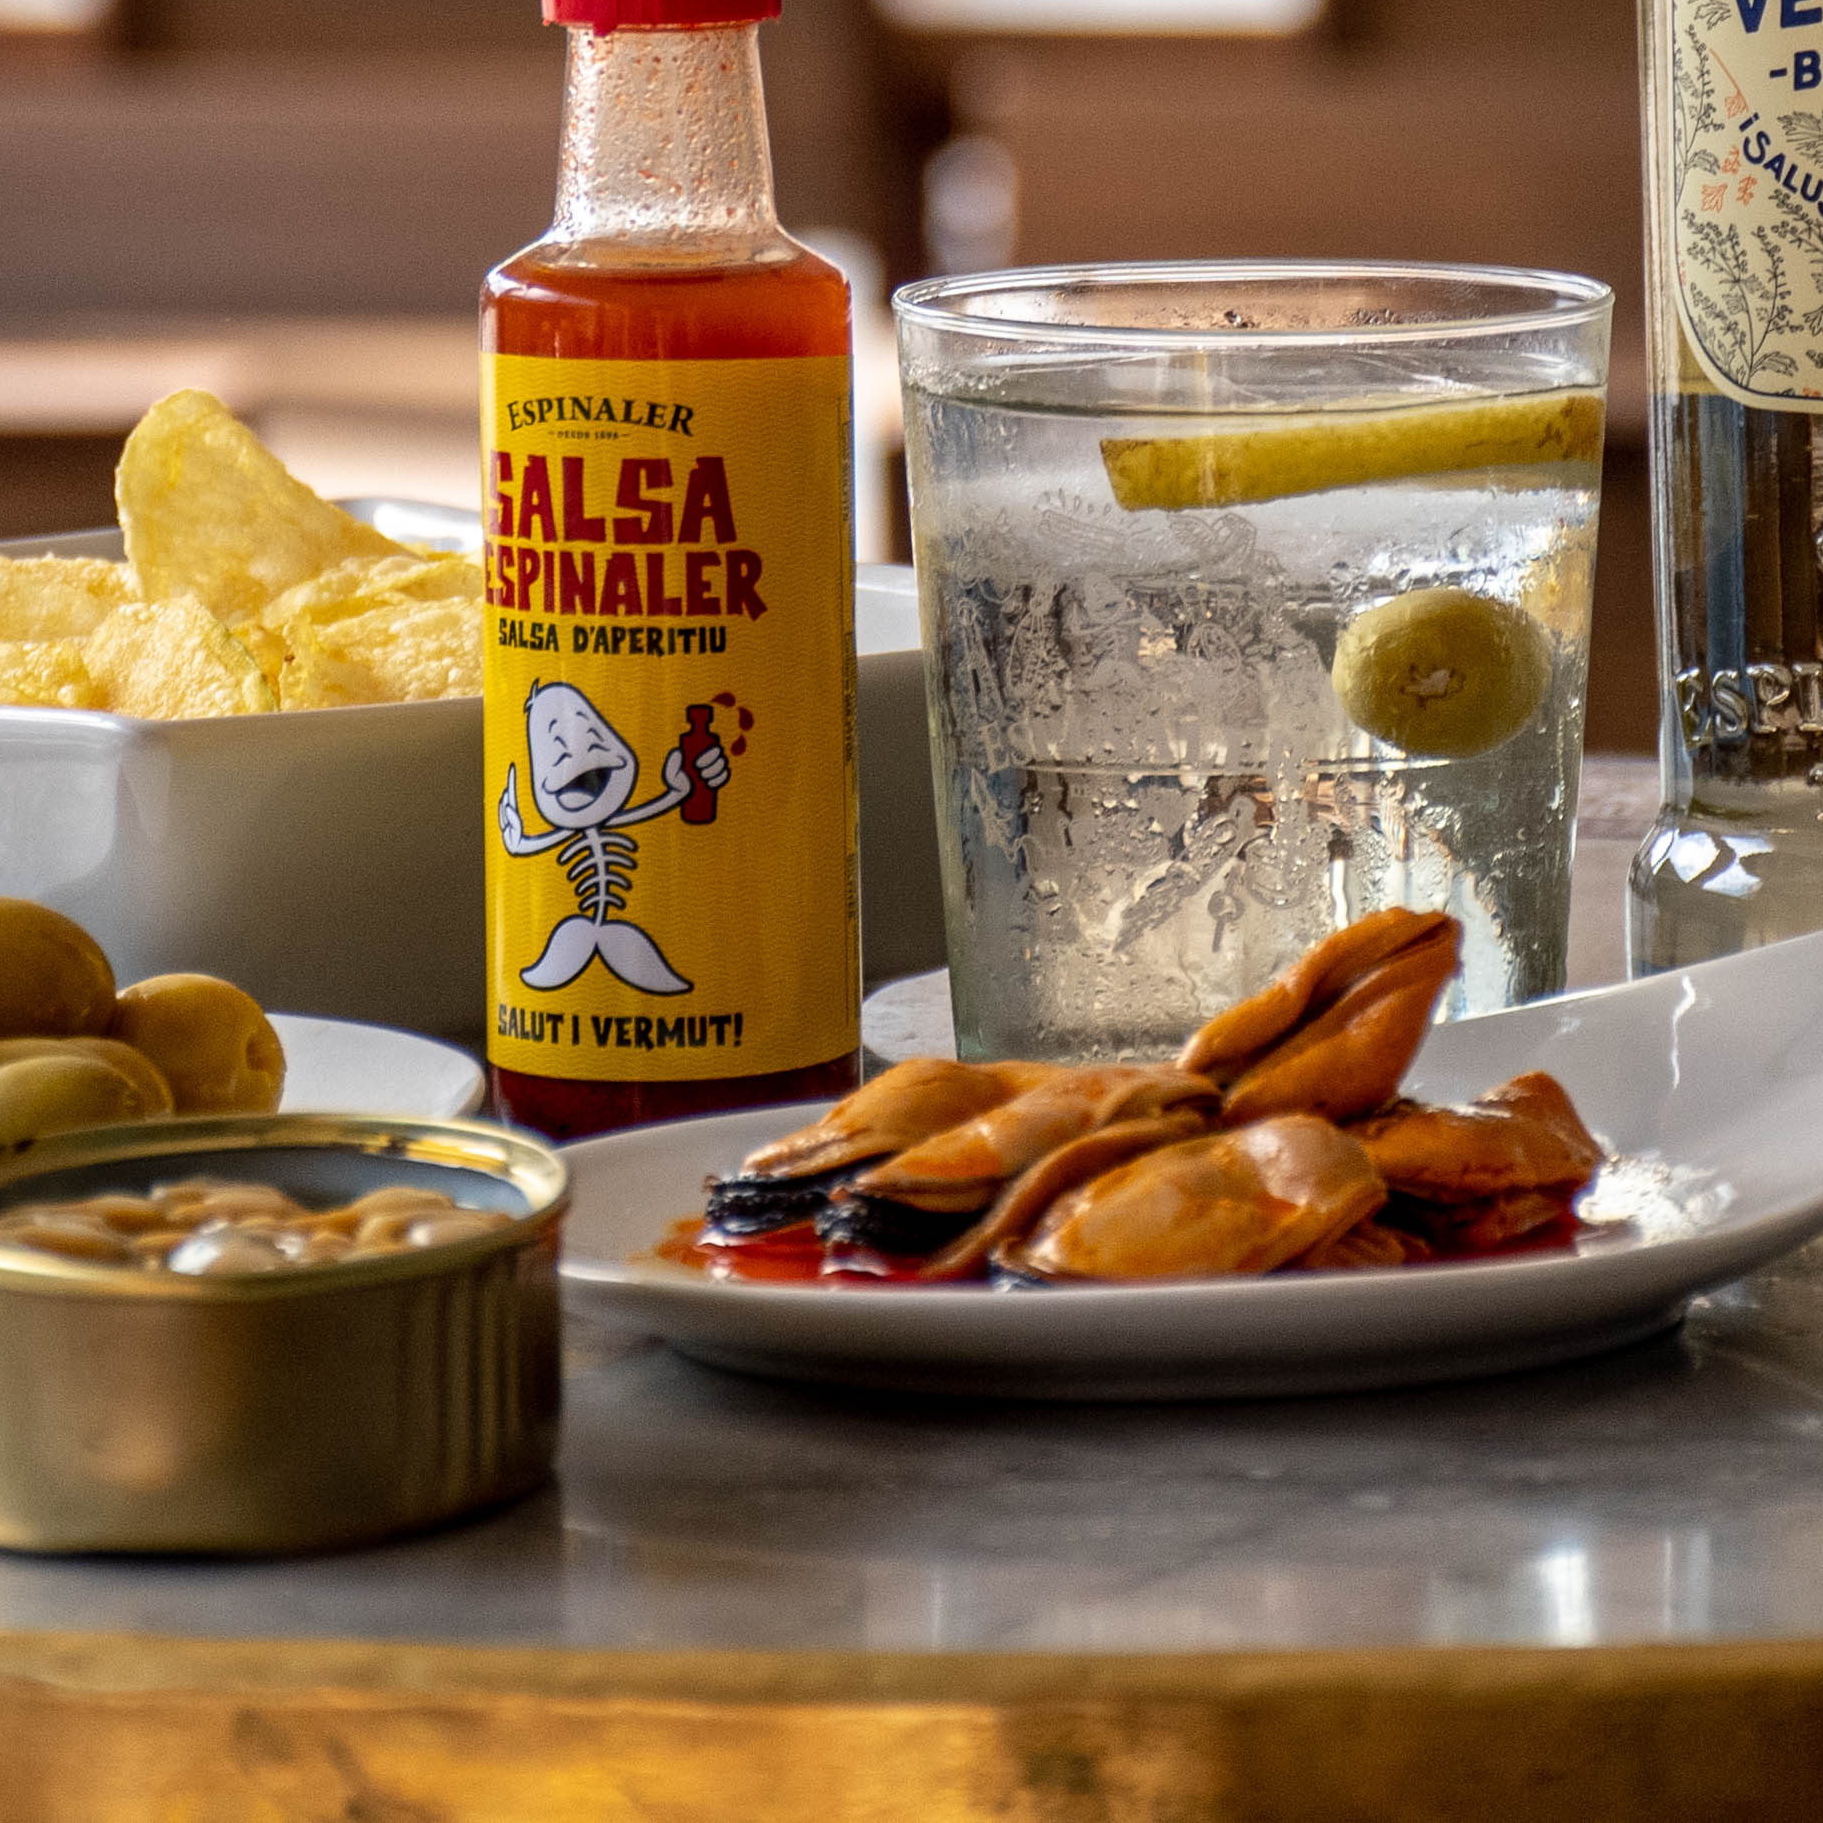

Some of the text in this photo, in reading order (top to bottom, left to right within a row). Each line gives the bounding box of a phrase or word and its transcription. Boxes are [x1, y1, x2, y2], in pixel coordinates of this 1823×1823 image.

[506, 396, 694, 437] ESPINALER
[489, 450, 737, 545] SALSA
[484, 538, 768, 622] ESPINALER
[498, 617, 727, 657] SALSA D'APERITIU
[498, 1004, 743, 1051] SALUT I VERMUT!
